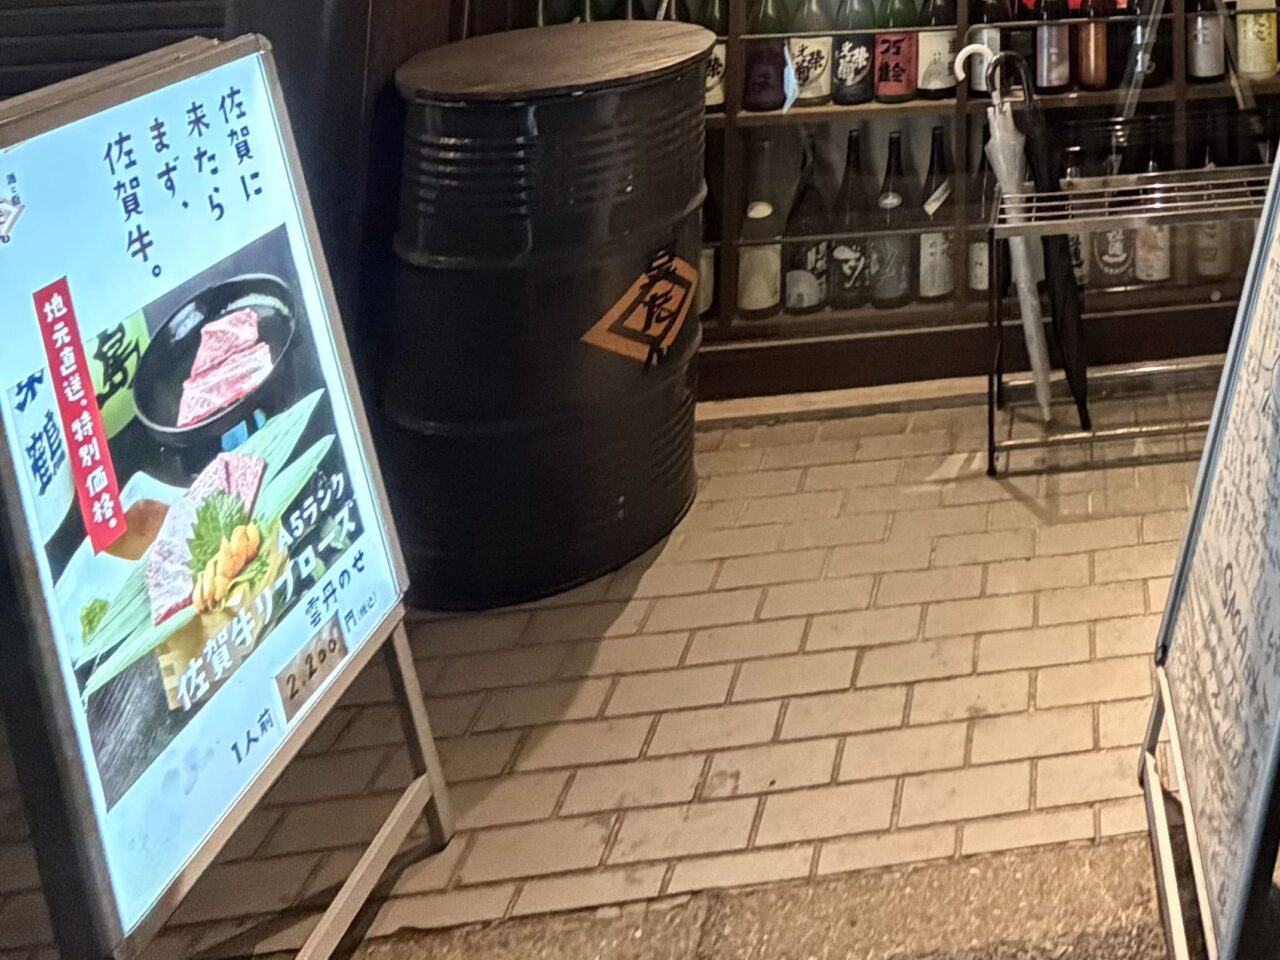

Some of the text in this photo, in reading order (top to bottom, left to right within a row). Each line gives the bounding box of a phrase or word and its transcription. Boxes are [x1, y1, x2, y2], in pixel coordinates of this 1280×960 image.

[150, 118, 190, 210] まず、
[186, 102, 225, 222] 来たら
[218, 86, 263, 203] 佐賀に
[103, 131, 162, 278] 佐賀牛。
[277, 472, 345, 553] A5ランク
[305, 550, 365, 628] 雲丹のせ
[231, 707, 275, 765] 1人前
